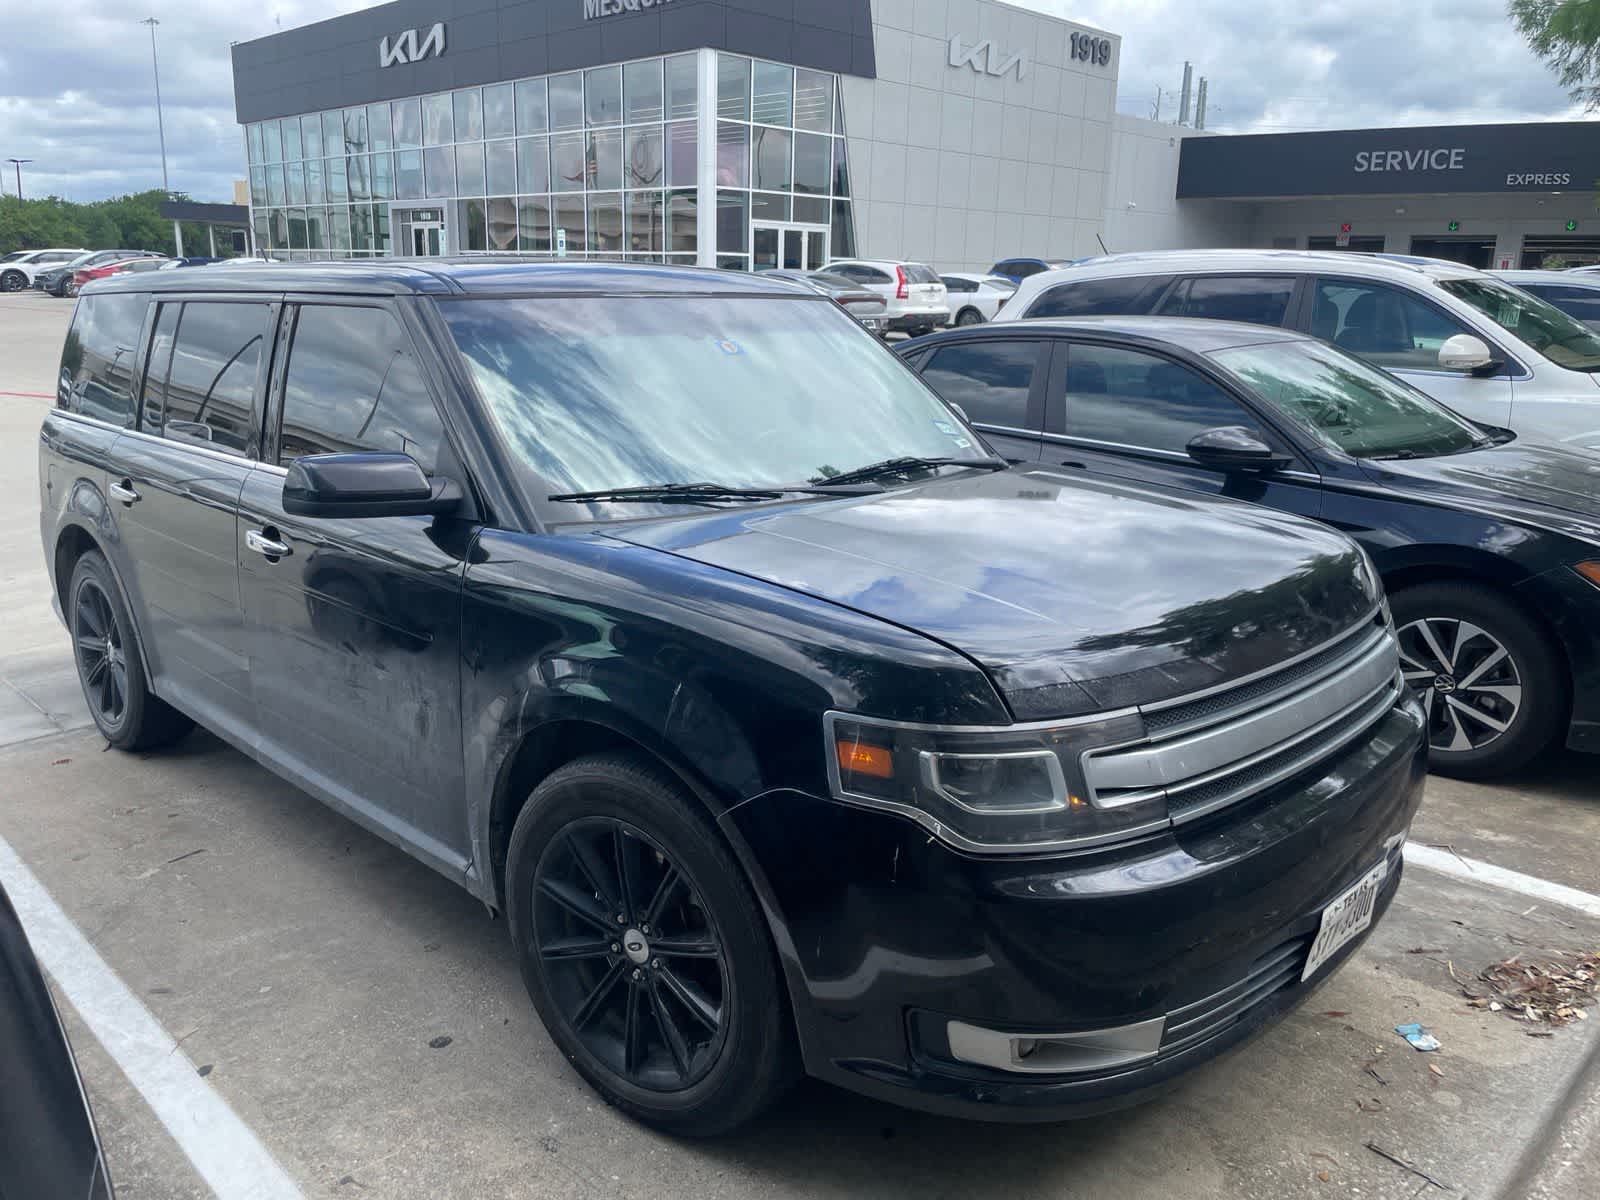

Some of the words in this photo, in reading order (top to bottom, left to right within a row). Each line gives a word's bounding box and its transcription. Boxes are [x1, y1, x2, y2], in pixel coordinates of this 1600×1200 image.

[380, 22, 444, 68] KIA
[949, 33, 1026, 81] KIA
[1070, 32, 1111, 66] 1919
[1354, 149, 1465, 172] SERVICE
[1506, 173, 1570, 185] EXPRESS
